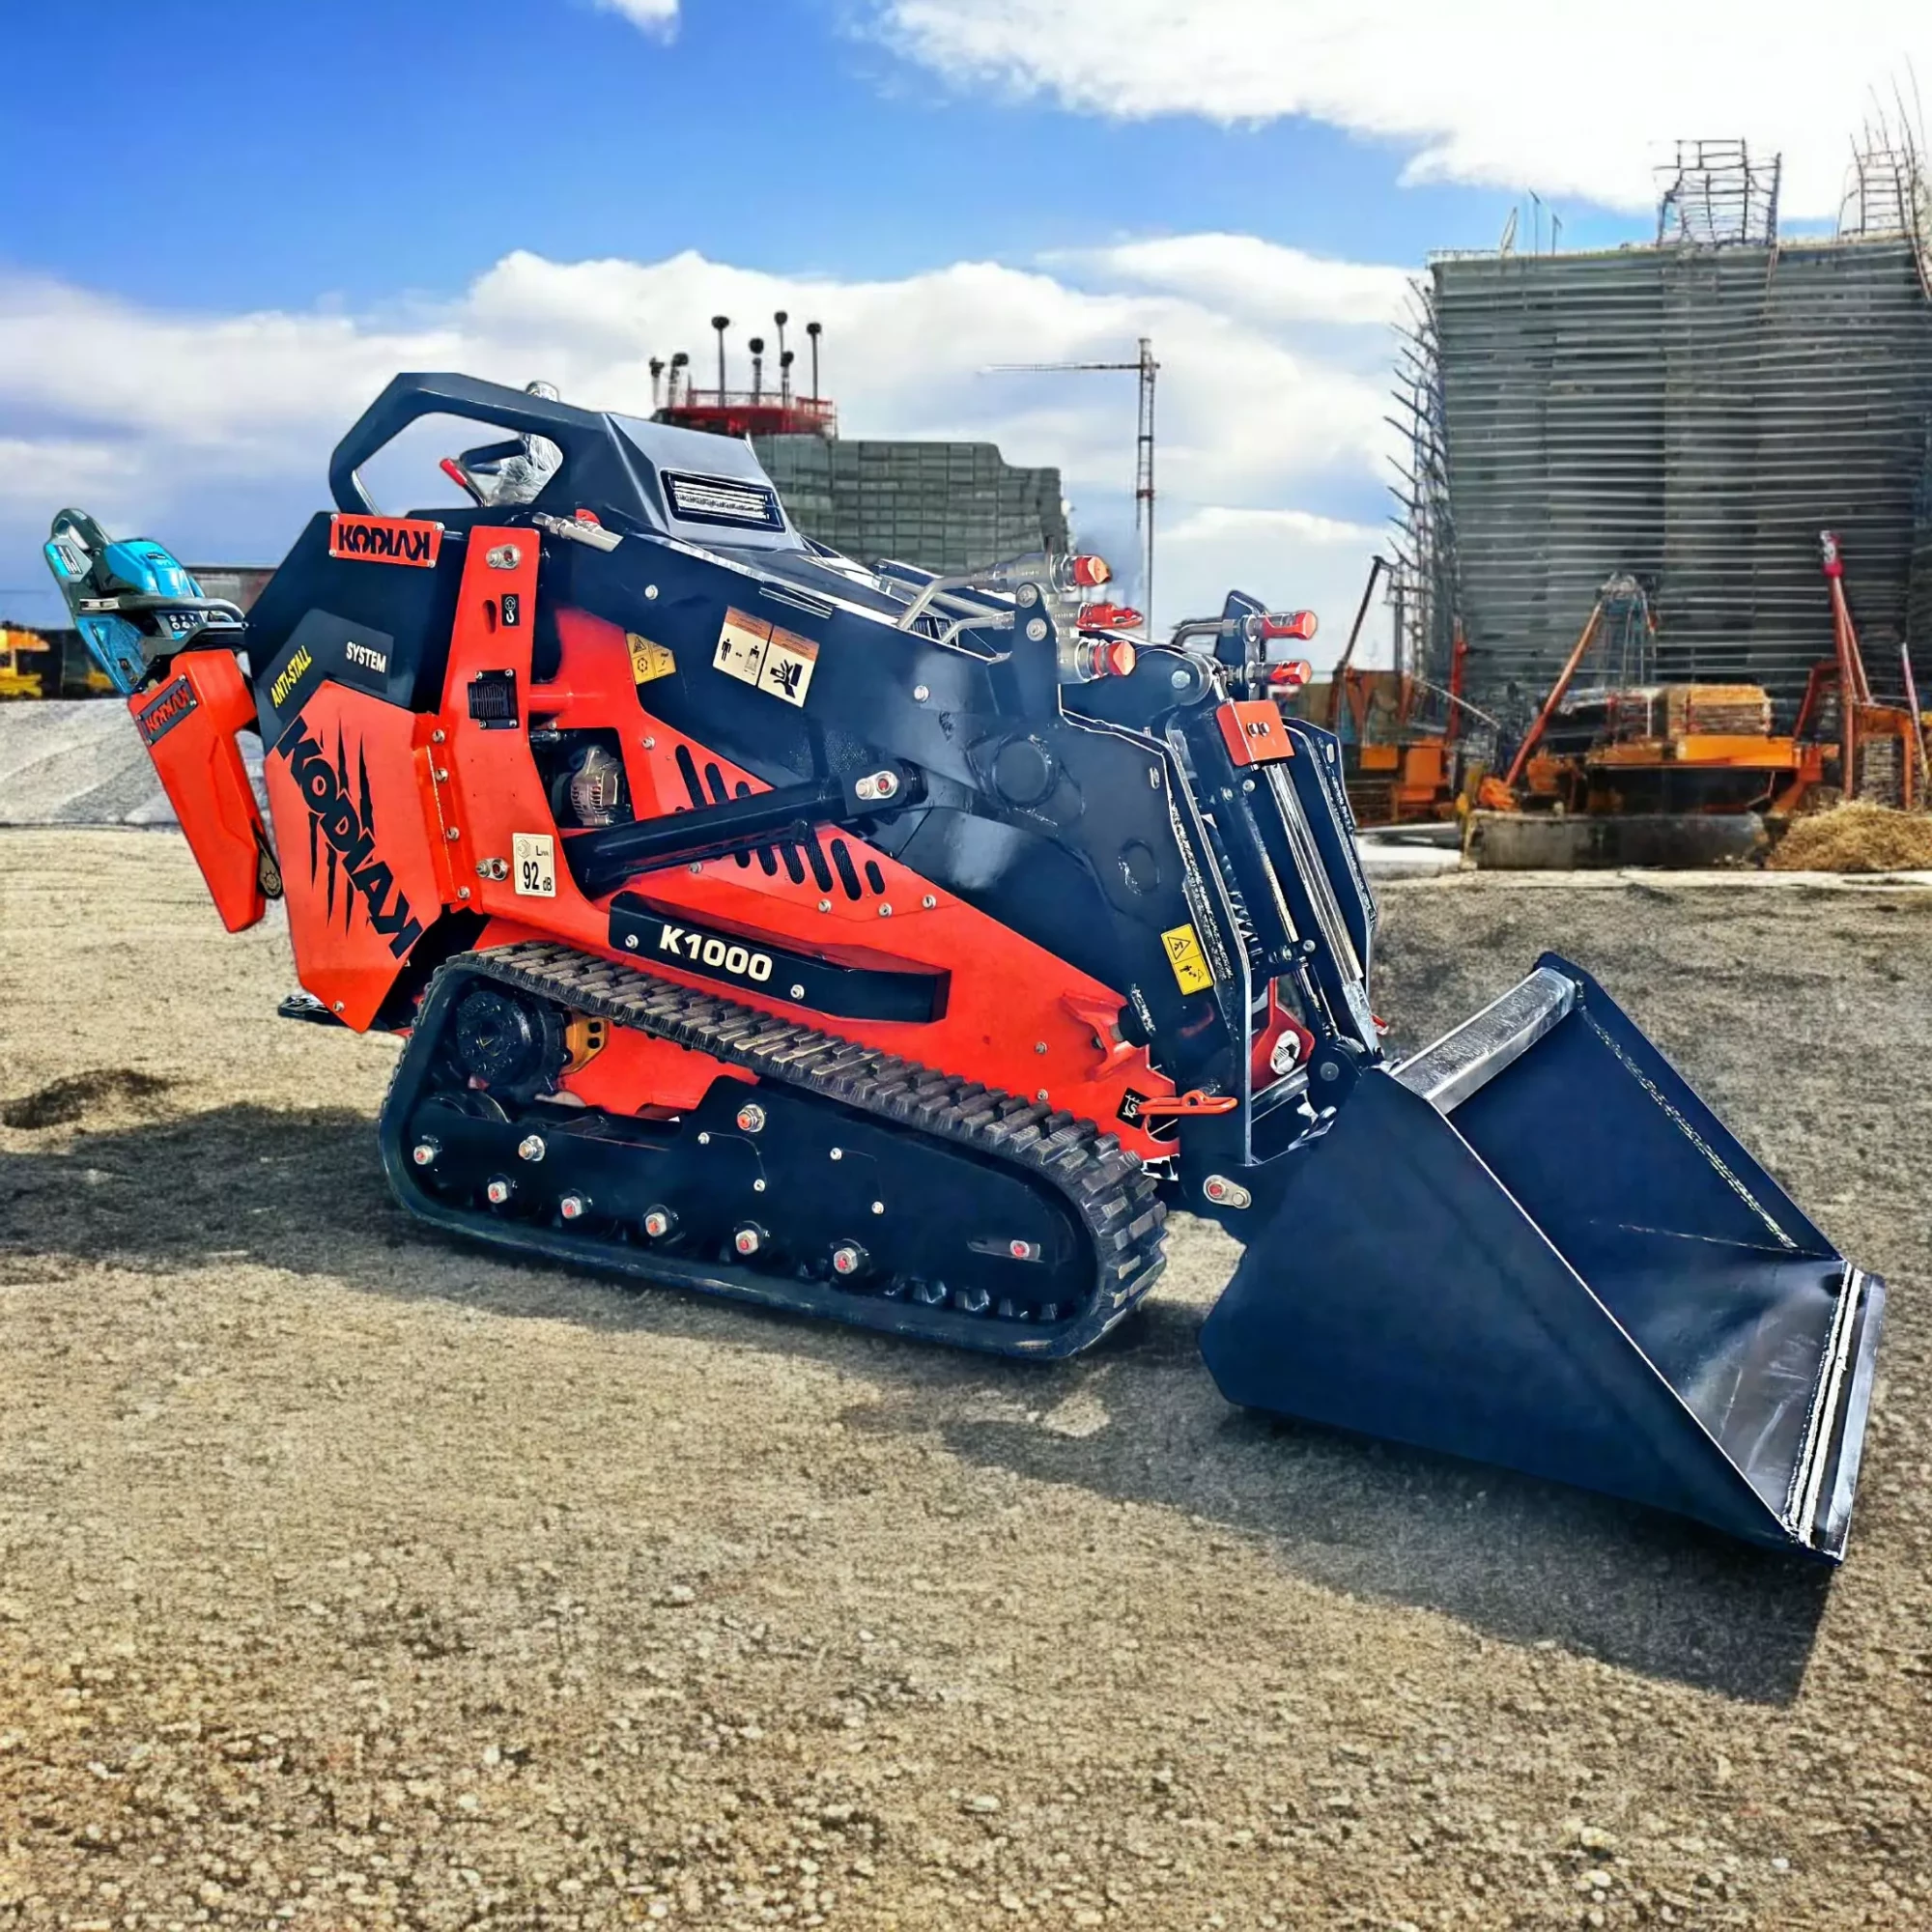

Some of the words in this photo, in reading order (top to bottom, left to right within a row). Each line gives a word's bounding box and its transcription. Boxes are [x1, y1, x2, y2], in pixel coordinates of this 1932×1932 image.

[338, 524, 431, 561] KODIAK
[270, 644, 312, 708] ANTI-STALL
[346, 641, 386, 673] SYSTEM
[276, 715, 423, 959] KODIAK
[523, 861, 540, 891] 92
[542, 876, 553, 892] dB
[659, 923, 773, 981] K1000
